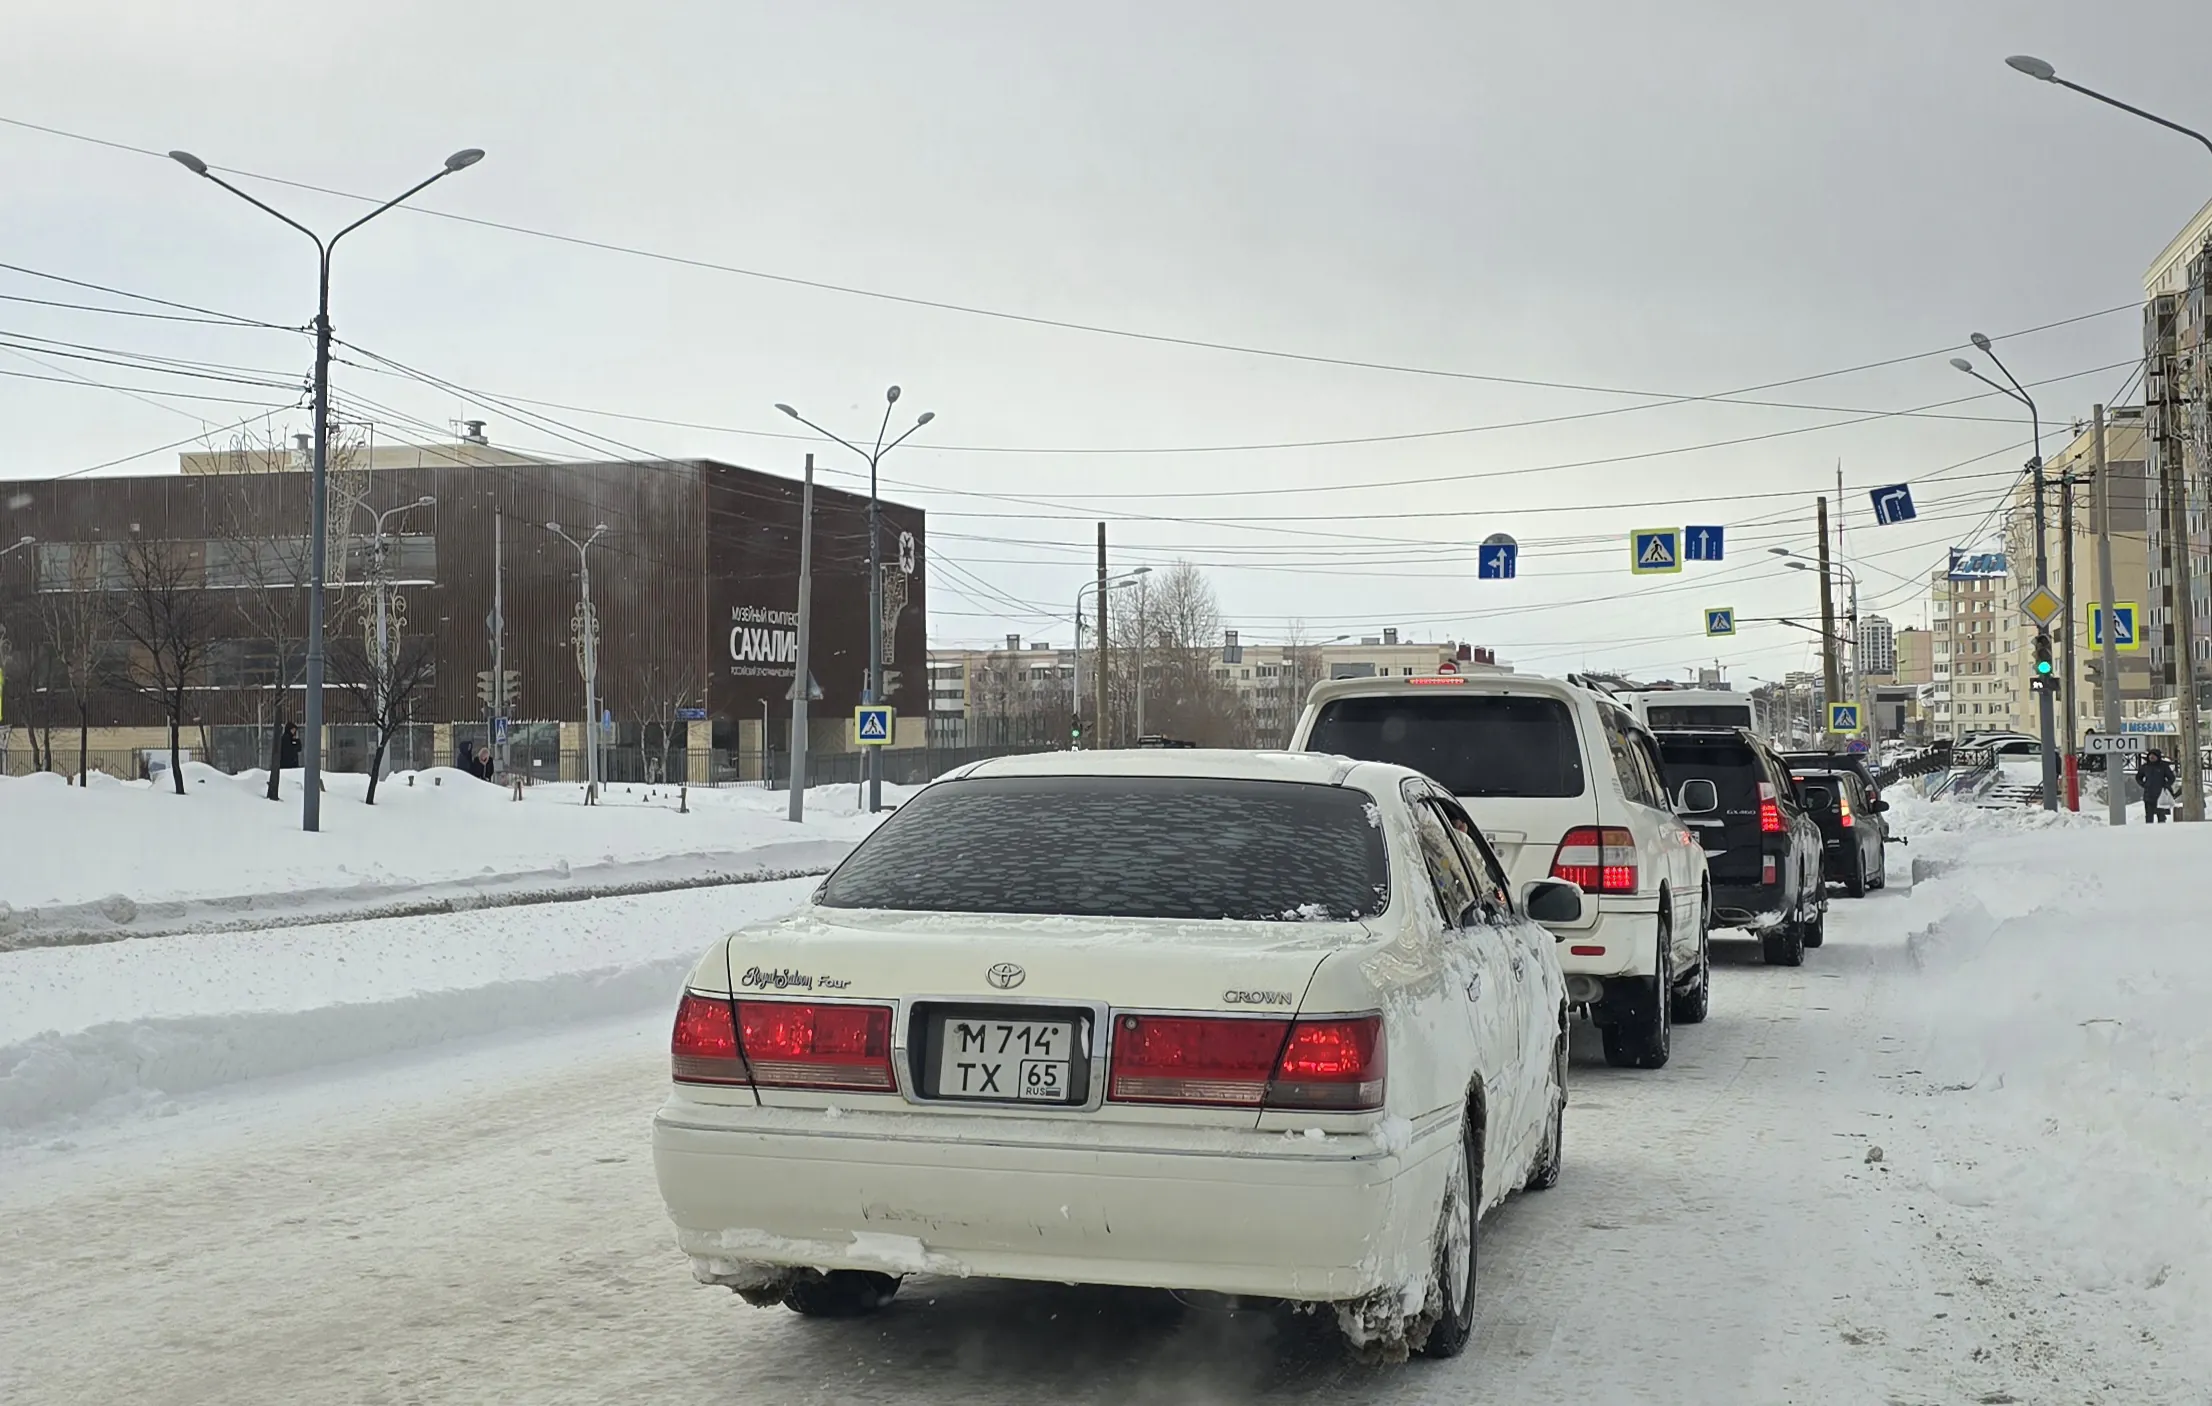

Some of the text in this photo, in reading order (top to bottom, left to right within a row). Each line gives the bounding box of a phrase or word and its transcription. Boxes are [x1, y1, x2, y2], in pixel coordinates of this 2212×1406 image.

[731, 605, 767, 623] МУЗЕЙНЫЙ
[2093, 737, 2138, 750] СТОП
[818, 975, 852, 989] Four
[1223, 990, 1292, 1005] CROWN
[1027, 1064, 1057, 1087] 65
[1025, 1086, 1046, 1097] RUS
